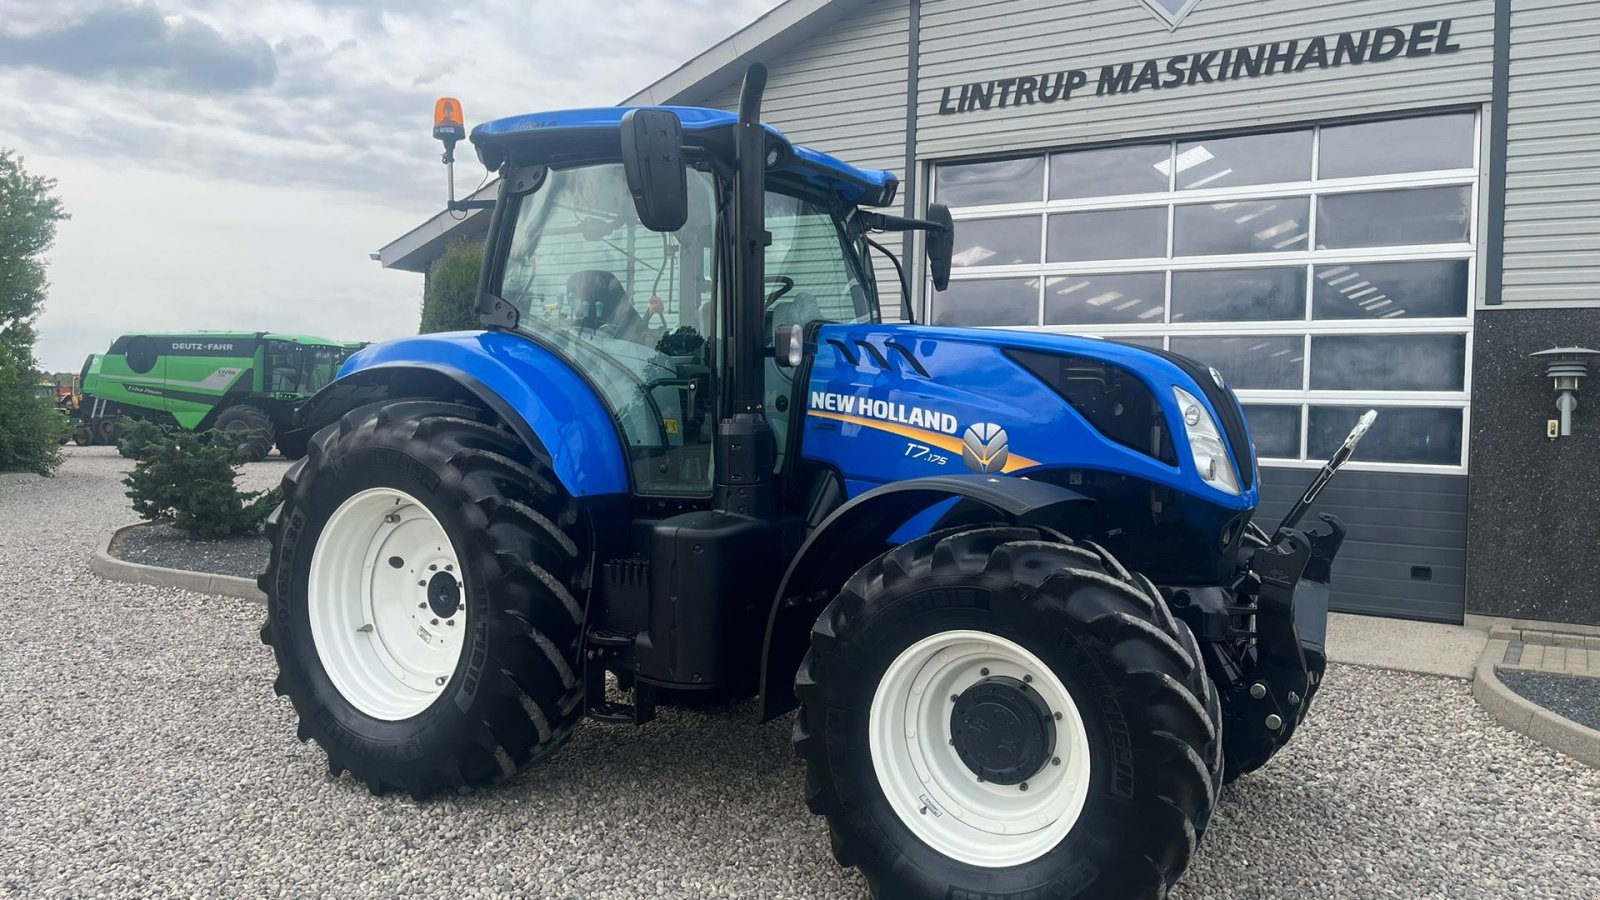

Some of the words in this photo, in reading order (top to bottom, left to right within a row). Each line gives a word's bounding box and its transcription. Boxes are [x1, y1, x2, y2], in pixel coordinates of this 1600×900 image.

[938, 70, 1087, 115] LINTRUP
[1096, 19, 1461, 95] MASKINHANDEL
[172, 343, 233, 352] DEUTZ-FAHR
[811, 391, 856, 413] NEW
[858, 397, 958, 434] HOLLAND
[904, 443, 948, 466] T7.175
